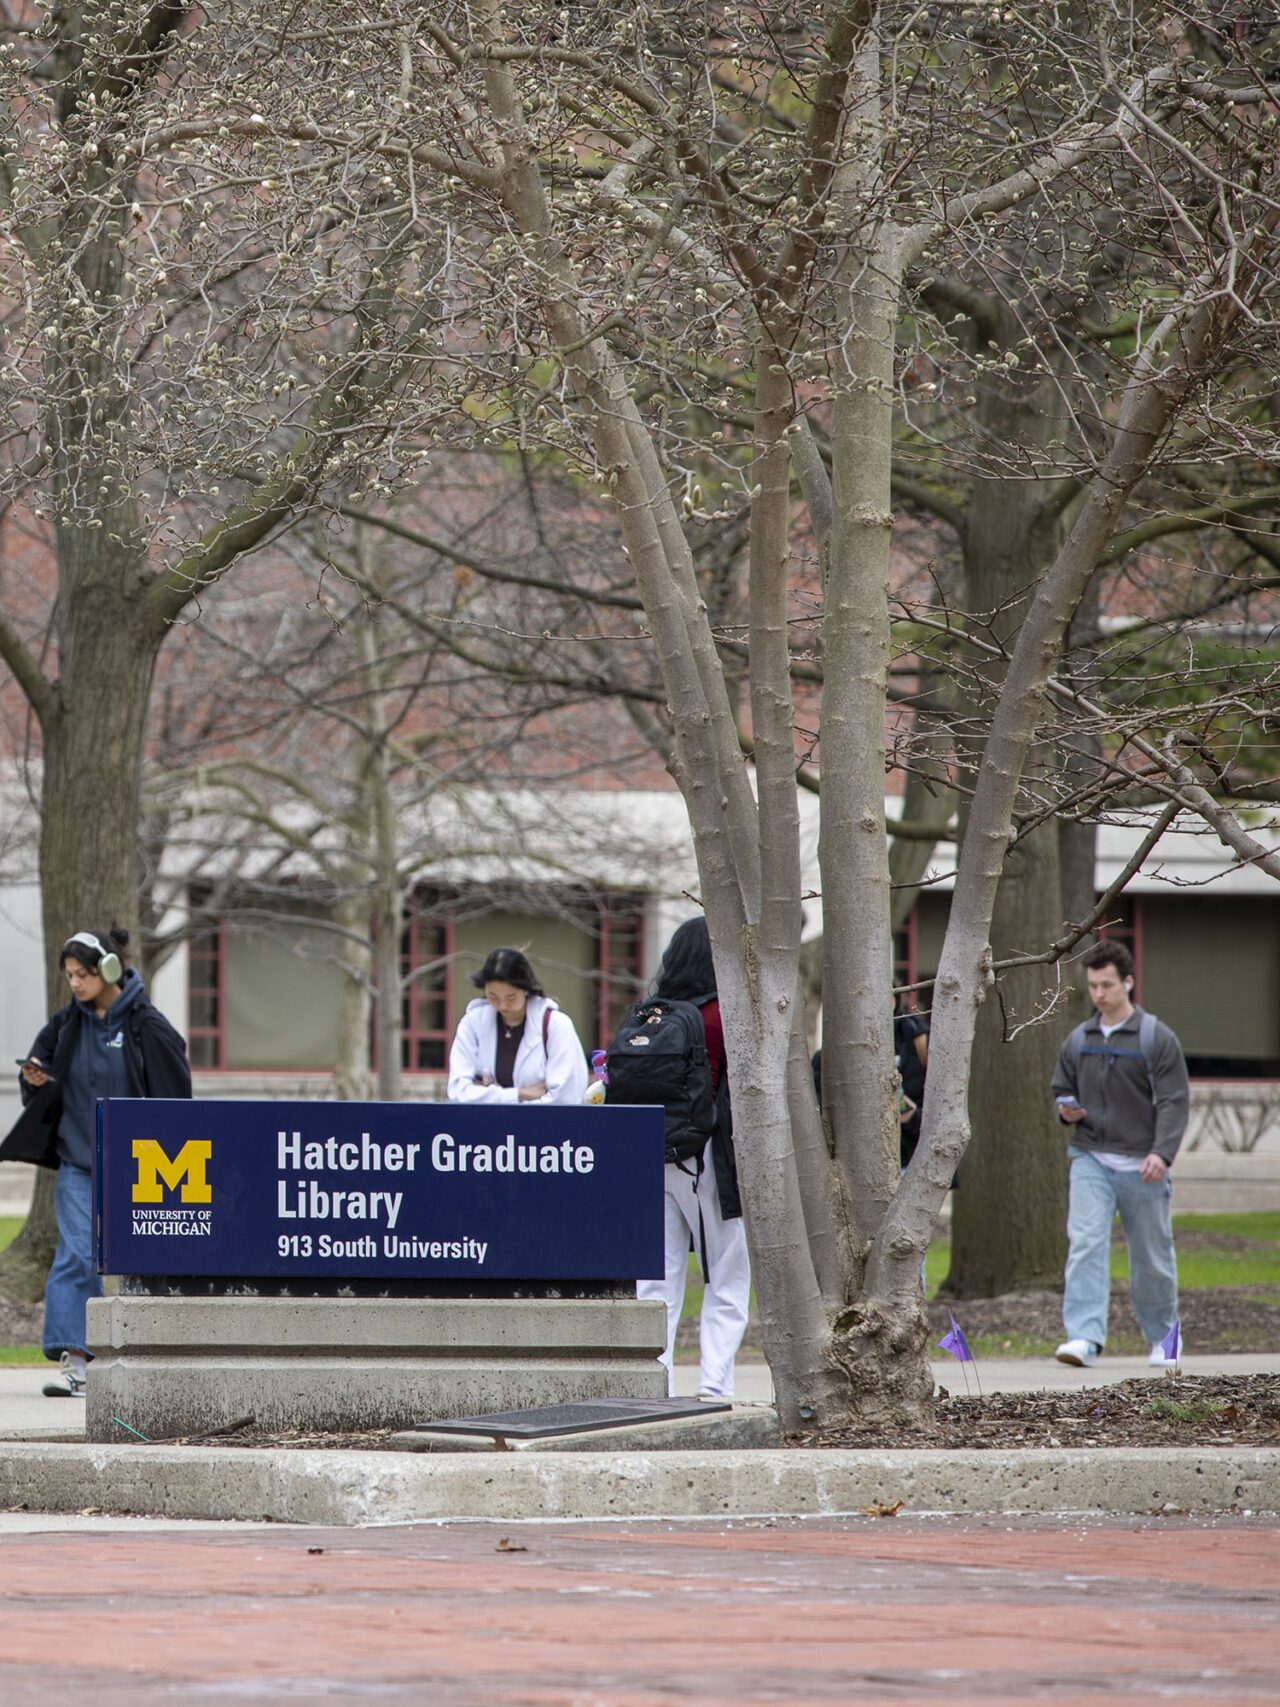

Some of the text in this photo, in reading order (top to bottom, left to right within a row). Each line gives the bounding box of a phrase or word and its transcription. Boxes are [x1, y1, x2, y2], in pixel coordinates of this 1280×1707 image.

[277, 1131, 595, 1174] Hatcher Graduate
[132, 1210, 212, 1220] UNIVERSITY OF
[277, 1180, 403, 1229] Library
[132, 1221, 212, 1236] MICHIGAN
[277, 1235, 488, 1264] 913 South University
